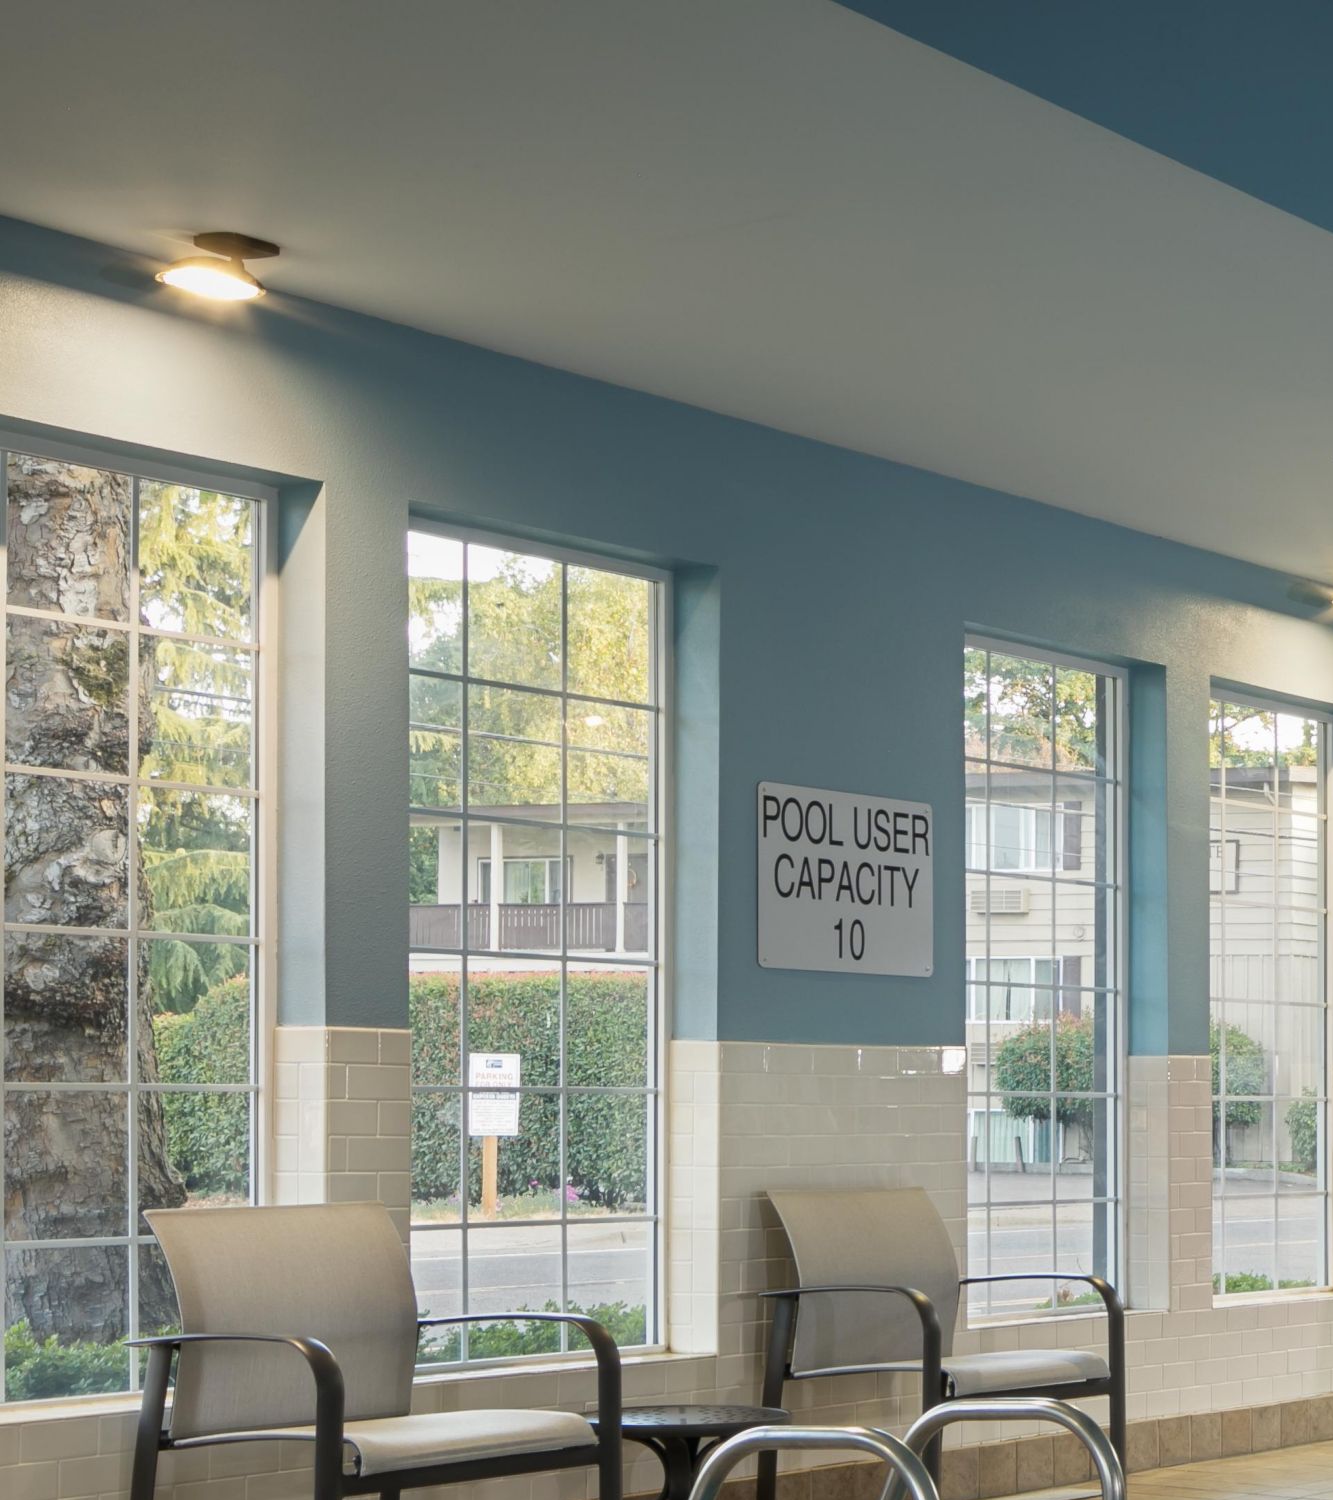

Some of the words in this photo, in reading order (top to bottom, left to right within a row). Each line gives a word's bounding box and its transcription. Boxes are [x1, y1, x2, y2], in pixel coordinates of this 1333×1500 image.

[763, 795, 844, 846] POOL
[854, 806, 929, 856] USER
[774, 853, 919, 908] CAPACITY
[834, 918, 865, 961] 10
